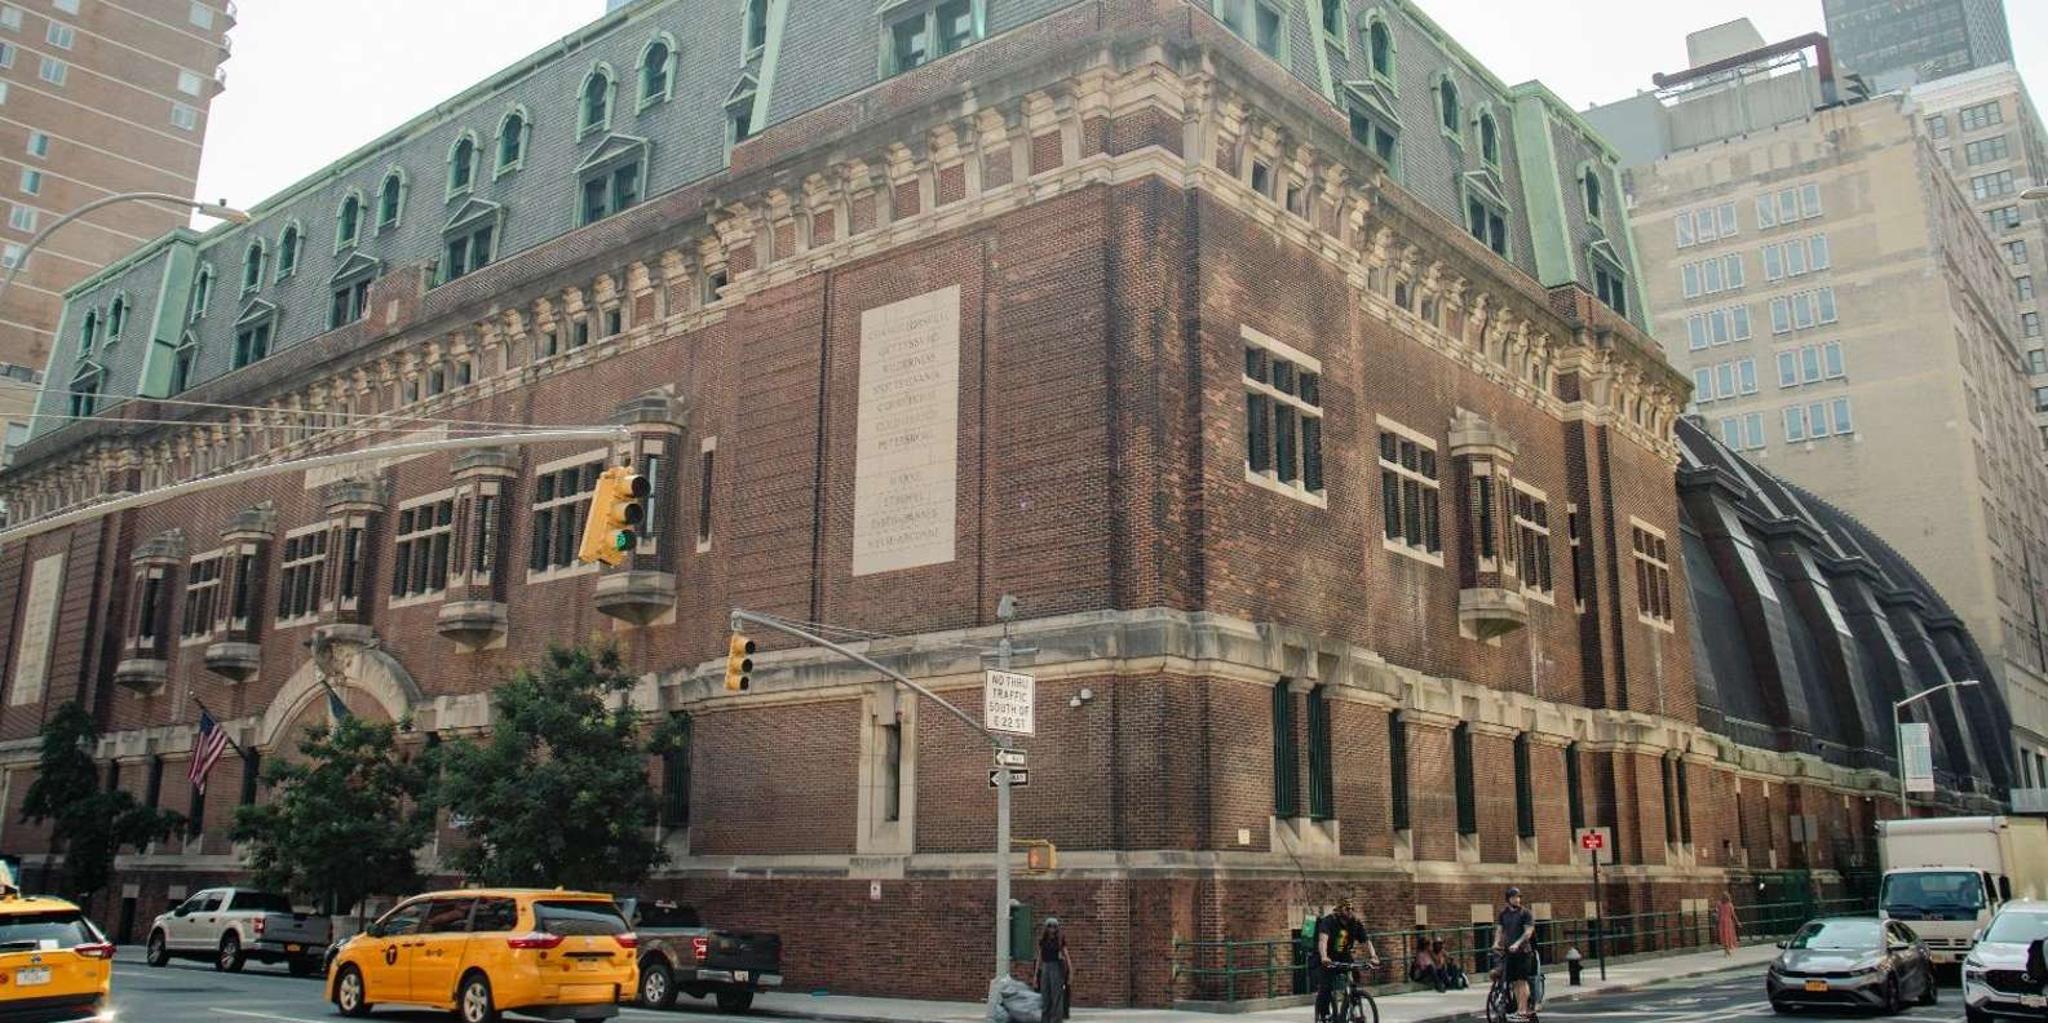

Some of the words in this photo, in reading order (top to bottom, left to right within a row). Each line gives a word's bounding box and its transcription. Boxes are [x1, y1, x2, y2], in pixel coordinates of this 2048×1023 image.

[992, 674, 1004, 685] NO
[1006, 677, 1028, 689] THRU
[993, 688, 1027, 702] TRAFFIC
[989, 702, 1016, 714] SOUTH
[1019, 705, 1029, 715] OF
[1001, 716, 1013, 727] 22
[1015, 718, 1025, 728] ST
